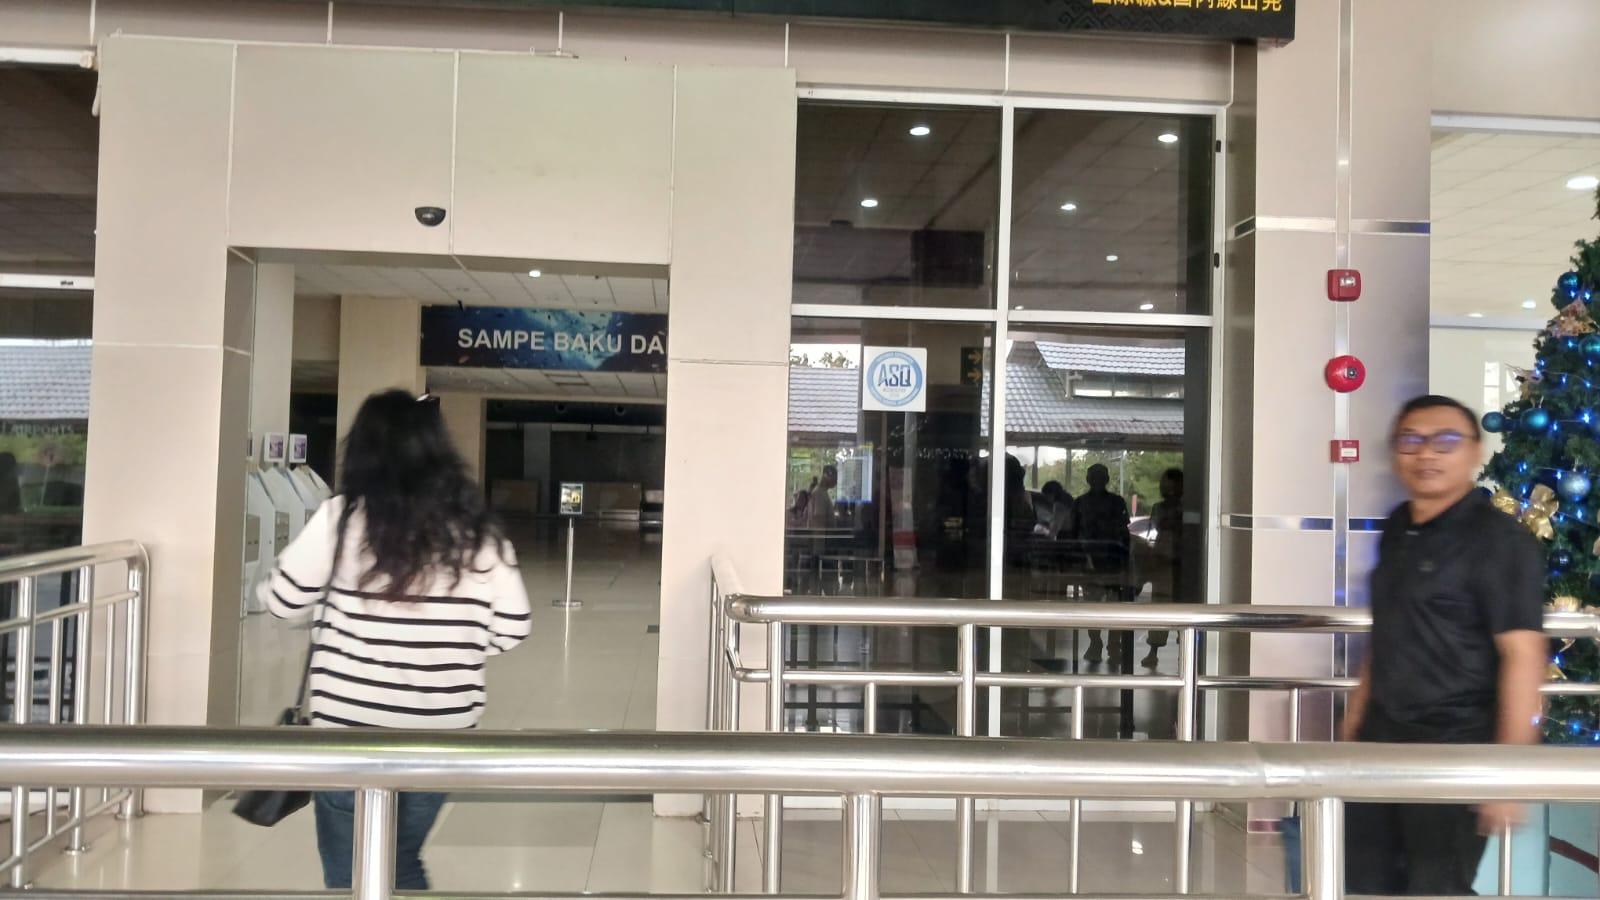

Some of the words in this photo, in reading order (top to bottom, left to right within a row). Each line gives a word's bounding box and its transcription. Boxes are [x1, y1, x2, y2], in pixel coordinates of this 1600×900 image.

[458, 328, 545, 350] SAMPE
[553, 331, 622, 353] BAKU
[630, 334, 668, 355] DA
[878, 363, 911, 387] ASQ
